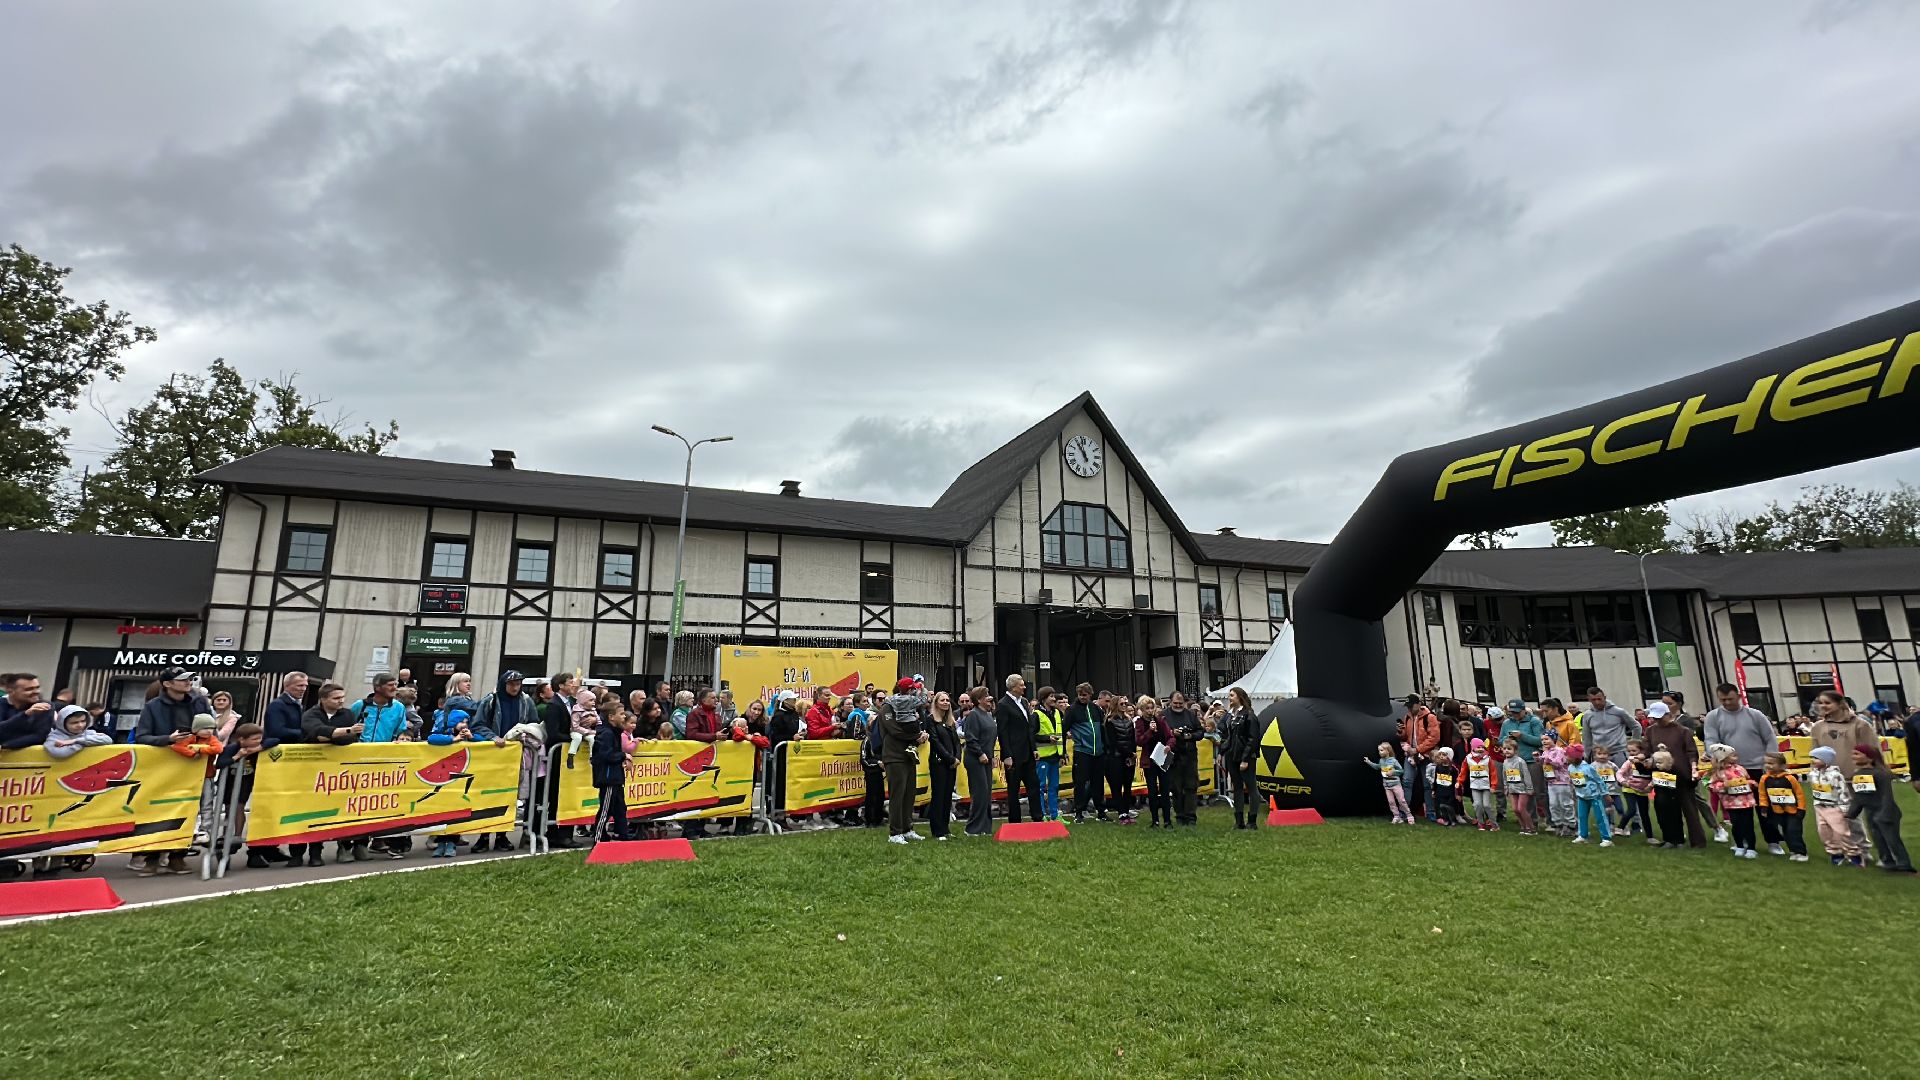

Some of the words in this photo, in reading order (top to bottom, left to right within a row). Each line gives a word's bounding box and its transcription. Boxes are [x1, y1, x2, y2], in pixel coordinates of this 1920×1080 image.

[420, 637, 468, 645] РАЗДЕВАЛКА
[171, 651, 237, 666] coffee
[315, 765, 408, 796] Арбузный
[839, 776, 867, 793] крос
[1256, 780, 1312, 795] ISCHER
[628, 782, 666, 801] кросс
[347, 793, 400, 817] кросс
